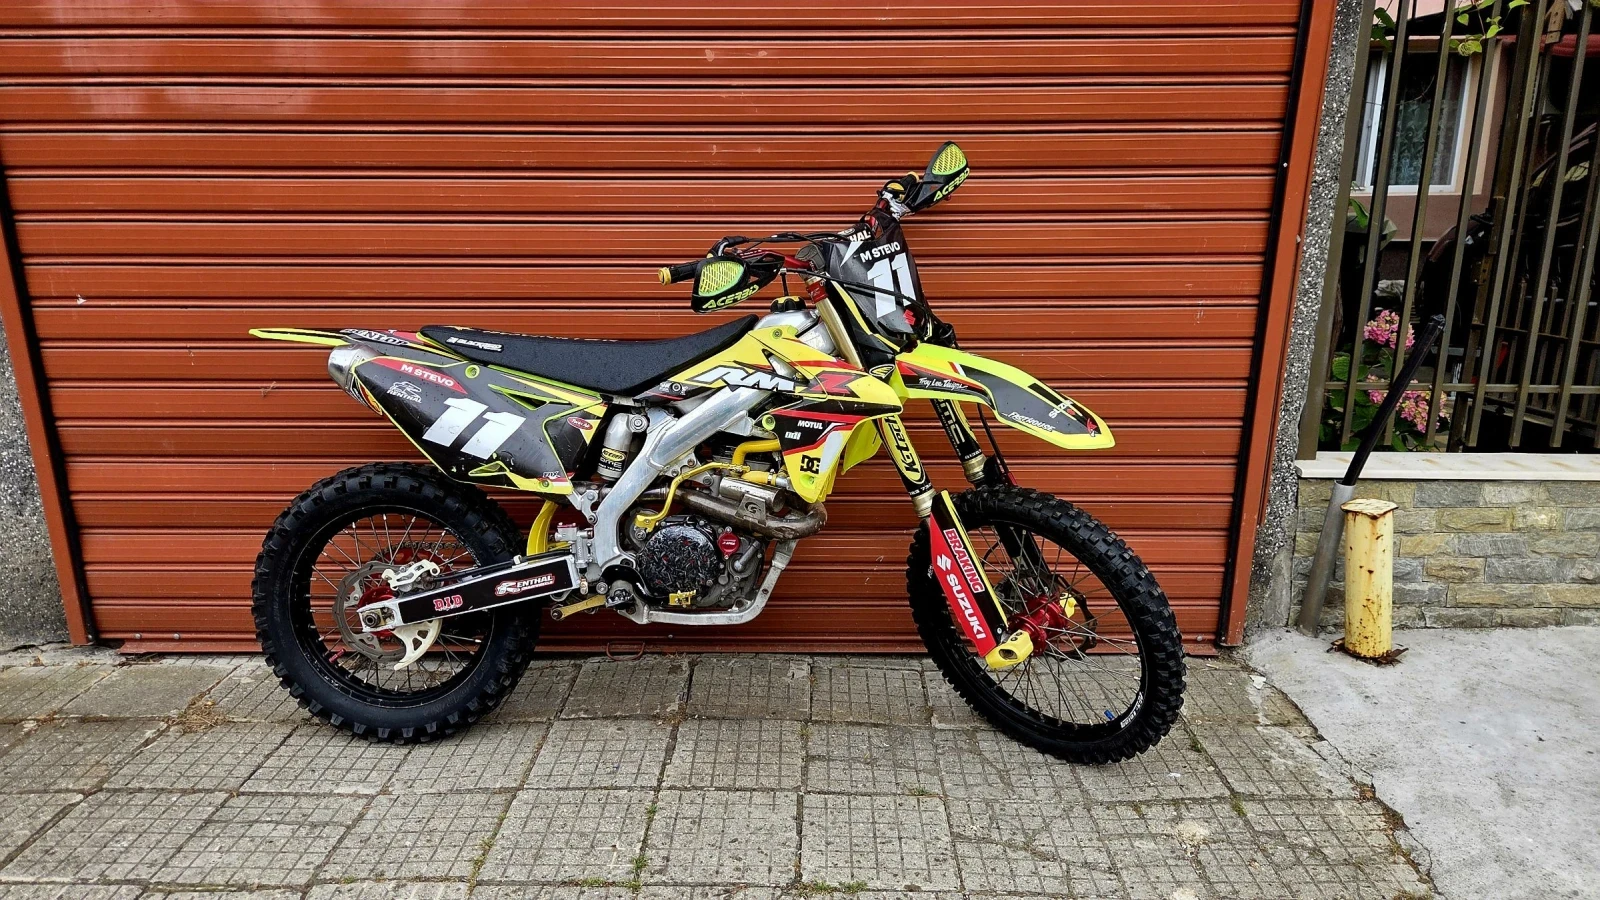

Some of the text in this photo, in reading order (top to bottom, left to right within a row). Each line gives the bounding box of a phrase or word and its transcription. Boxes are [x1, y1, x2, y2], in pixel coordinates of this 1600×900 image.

[859, 241, 901, 263] M STEVO
[867, 252, 917, 319] 11
[400, 364, 454, 387] M STEVO
[918, 377, 931, 388] Troy
[931, 378, 943, 387] Lee
[386, 389, 422, 404] RENTHAL
[421, 397, 527, 461] 11
[797, 419, 823, 430] MOTUL
[800, 454, 821, 475] DC
[943, 528, 985, 593] BRAKING
[946, 573, 987, 639] SUZUKI
